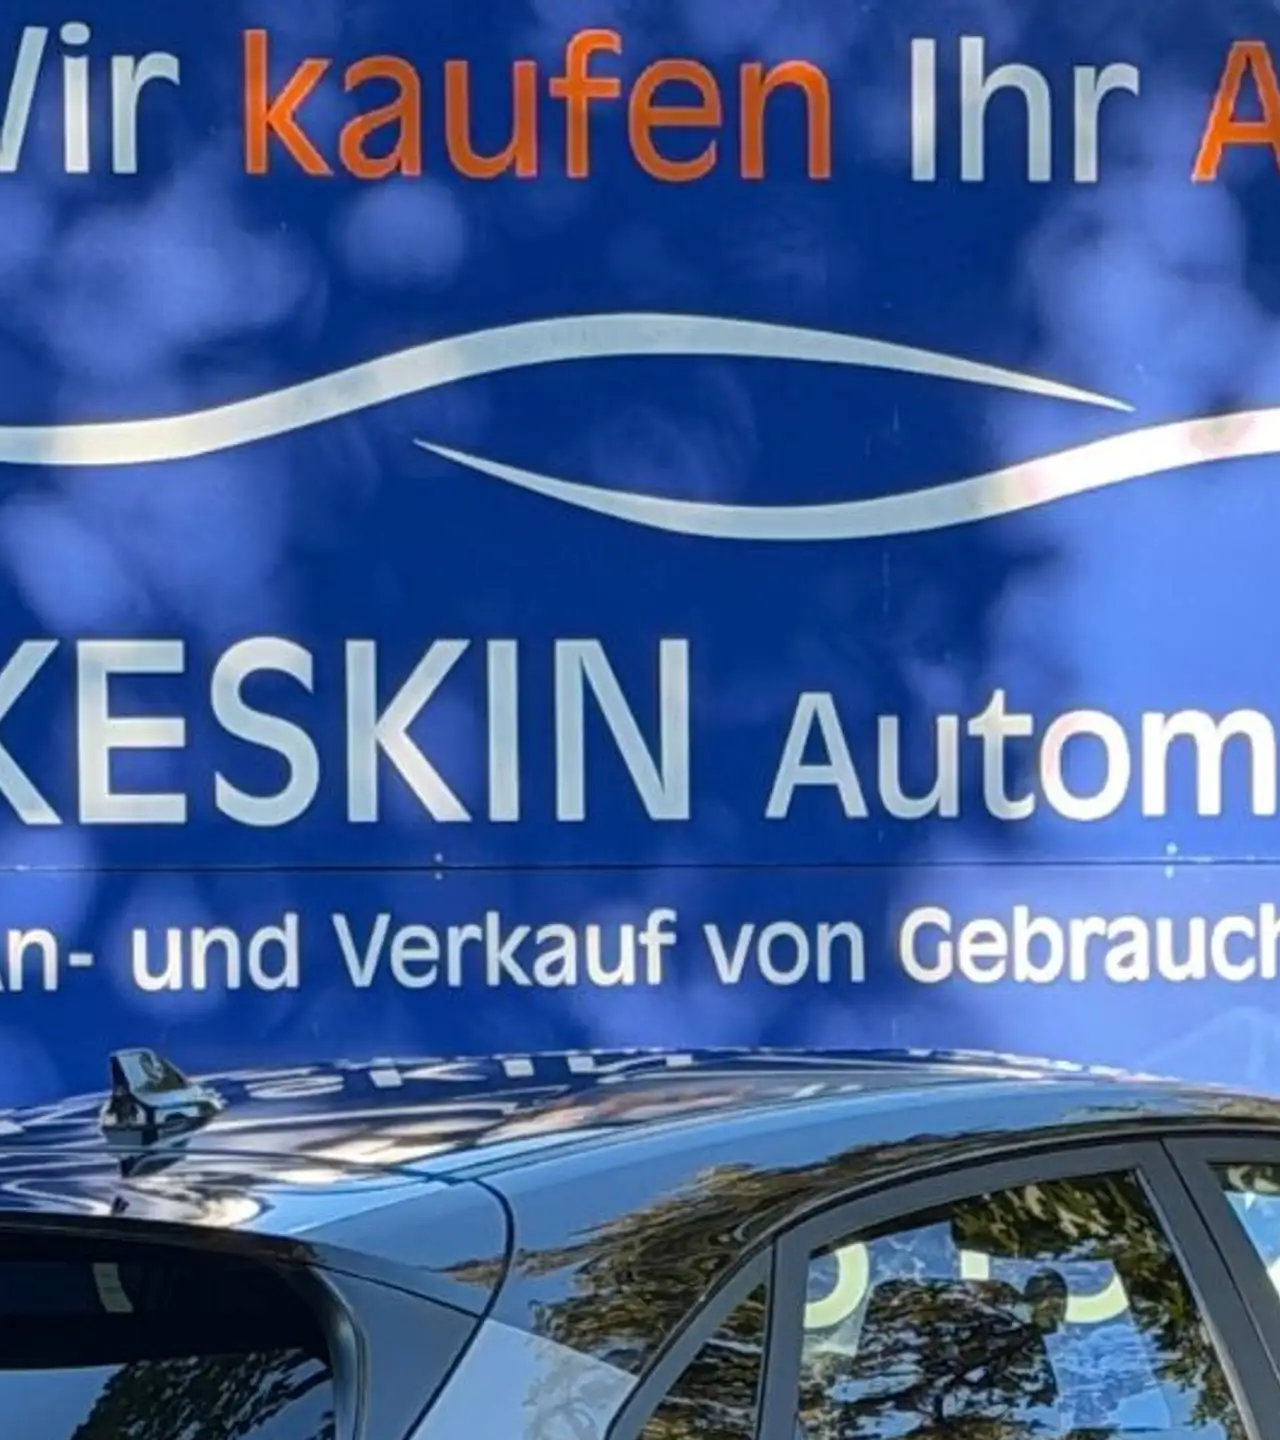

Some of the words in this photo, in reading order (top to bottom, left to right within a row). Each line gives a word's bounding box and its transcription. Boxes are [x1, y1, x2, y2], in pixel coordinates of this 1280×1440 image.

[243, 27, 831, 181] kaufen
[910, 35, 1140, 184] Ihr
[131, 912, 300, 992] und
[332, 908, 678, 989] Verkauf
[703, 921, 865, 985] von
